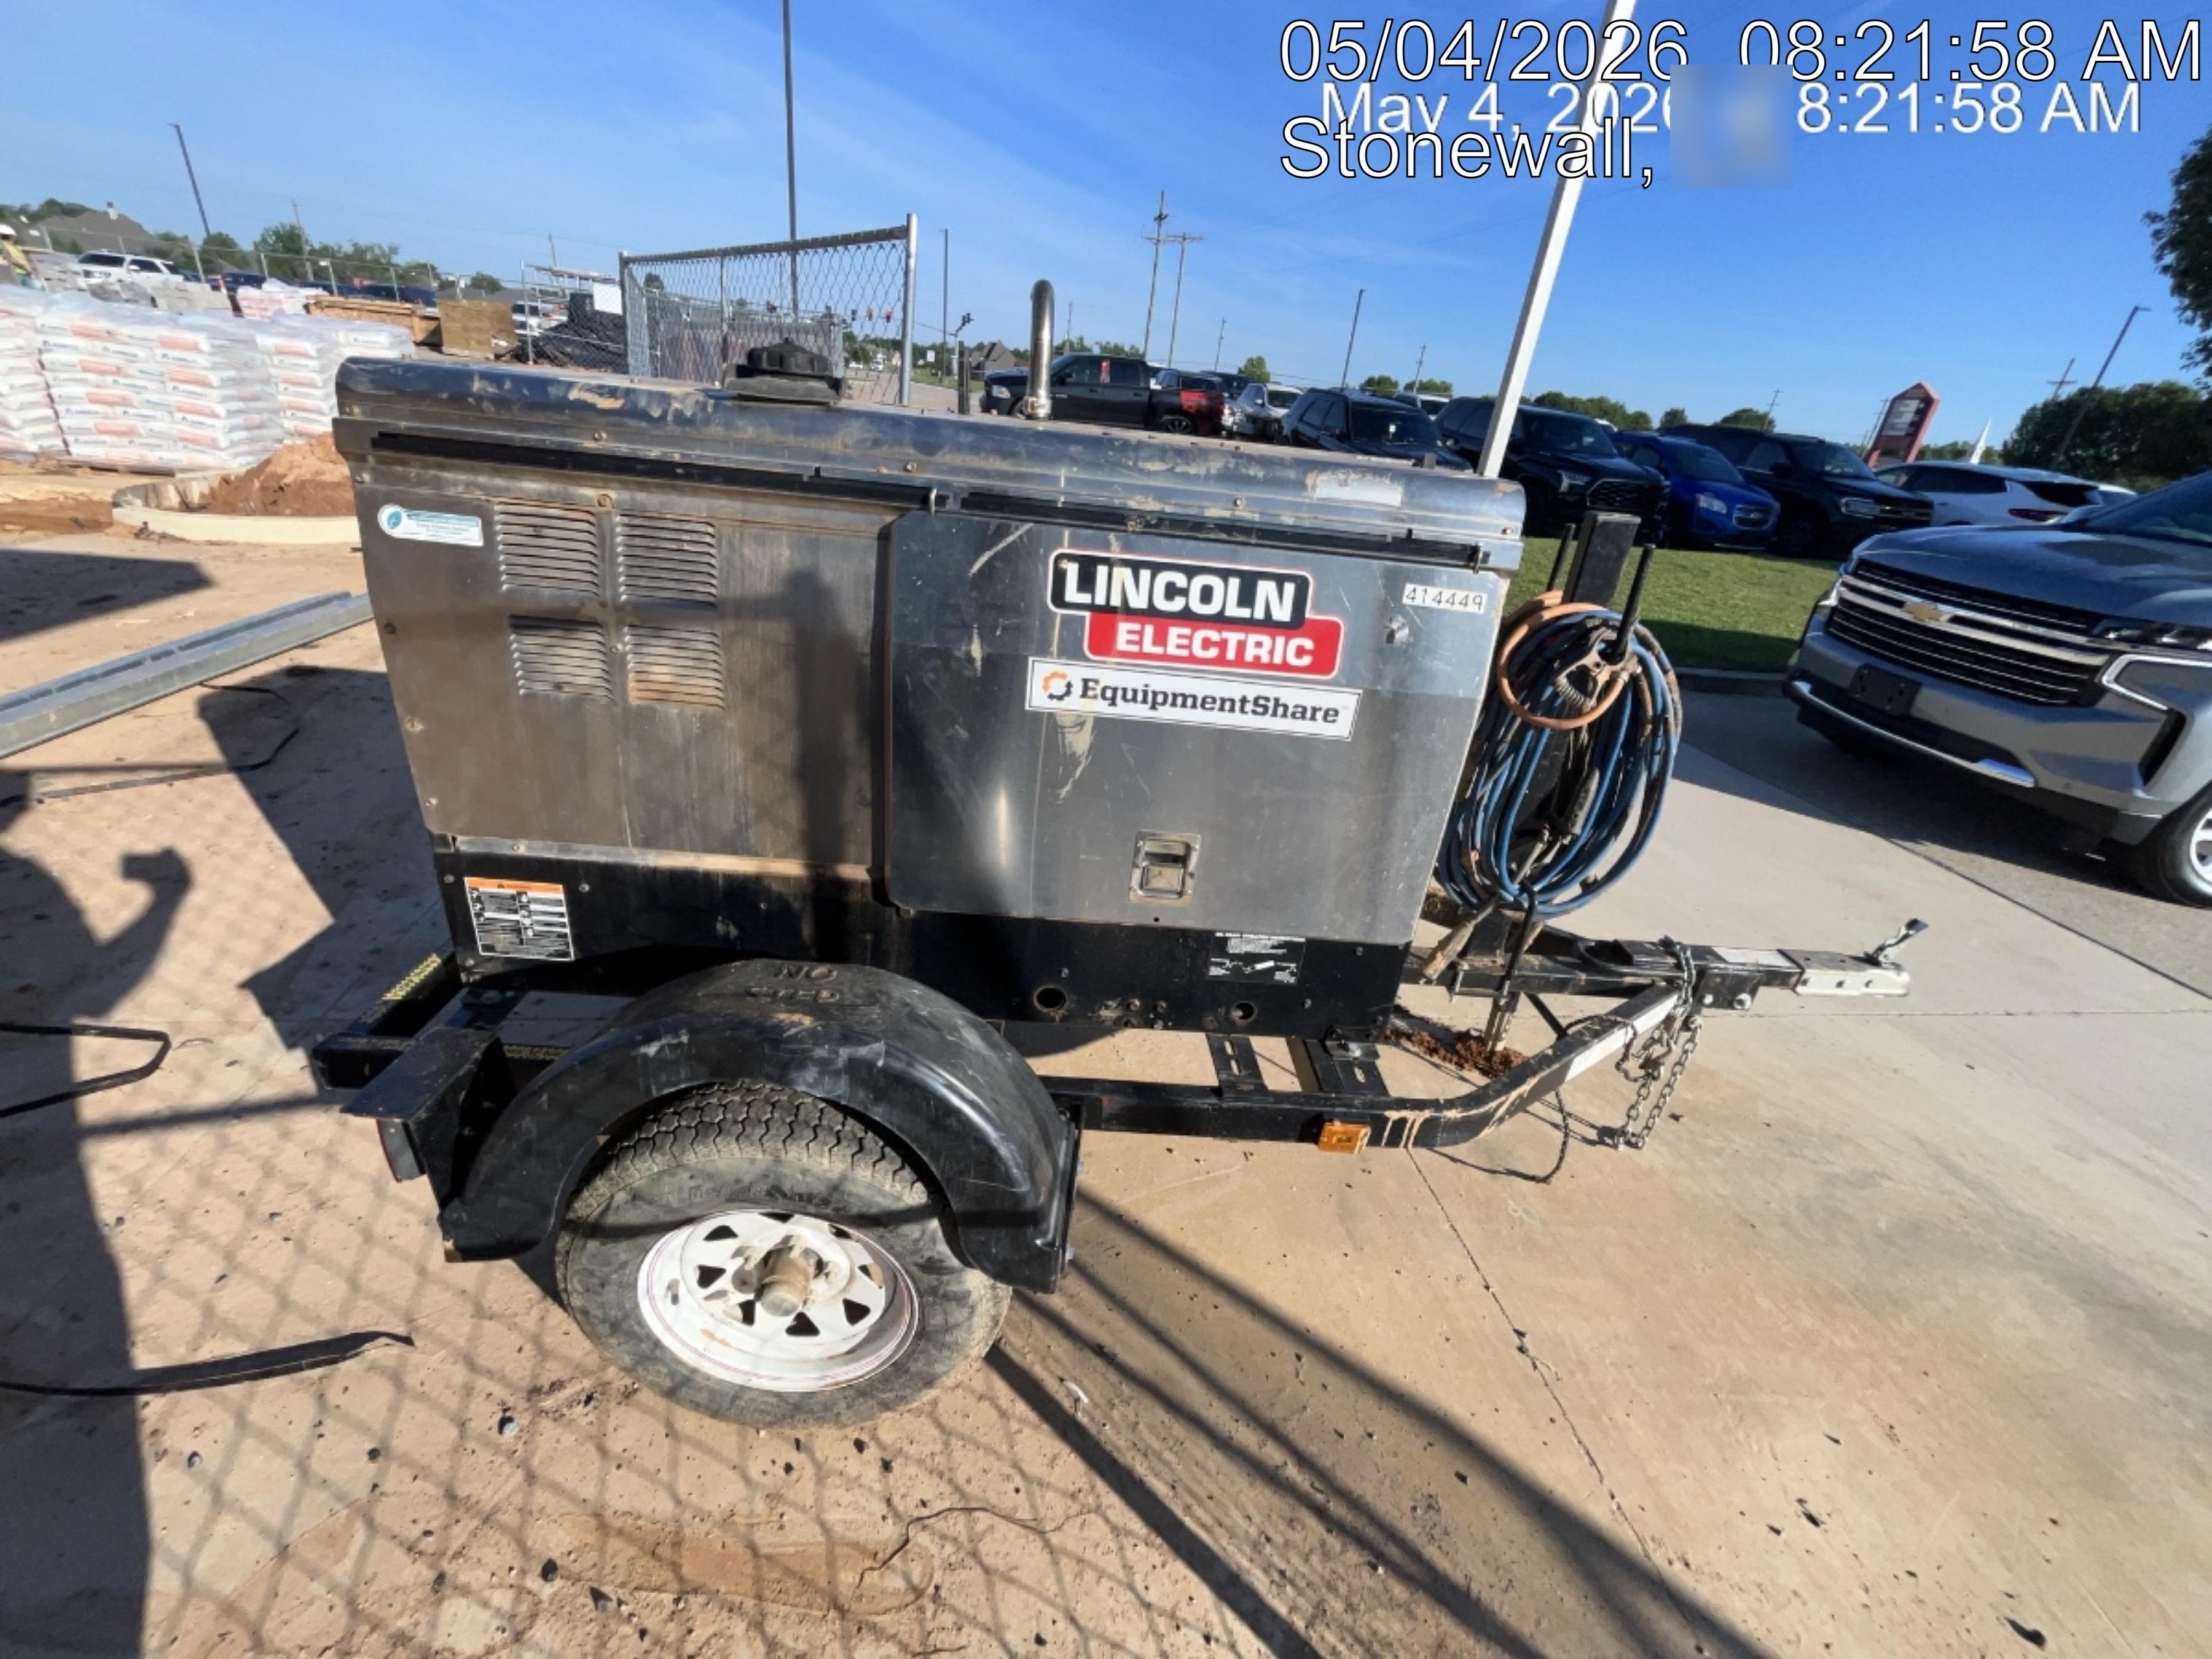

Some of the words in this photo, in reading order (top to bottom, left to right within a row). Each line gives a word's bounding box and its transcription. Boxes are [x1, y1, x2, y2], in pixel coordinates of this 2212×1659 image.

[1064, 561, 1295, 622] LINCOLN
[1406, 587, 1483, 611] 414449
[1116, 622, 1314, 667] ELECTRIC
[1080, 677, 1340, 724] EquipmentShare
